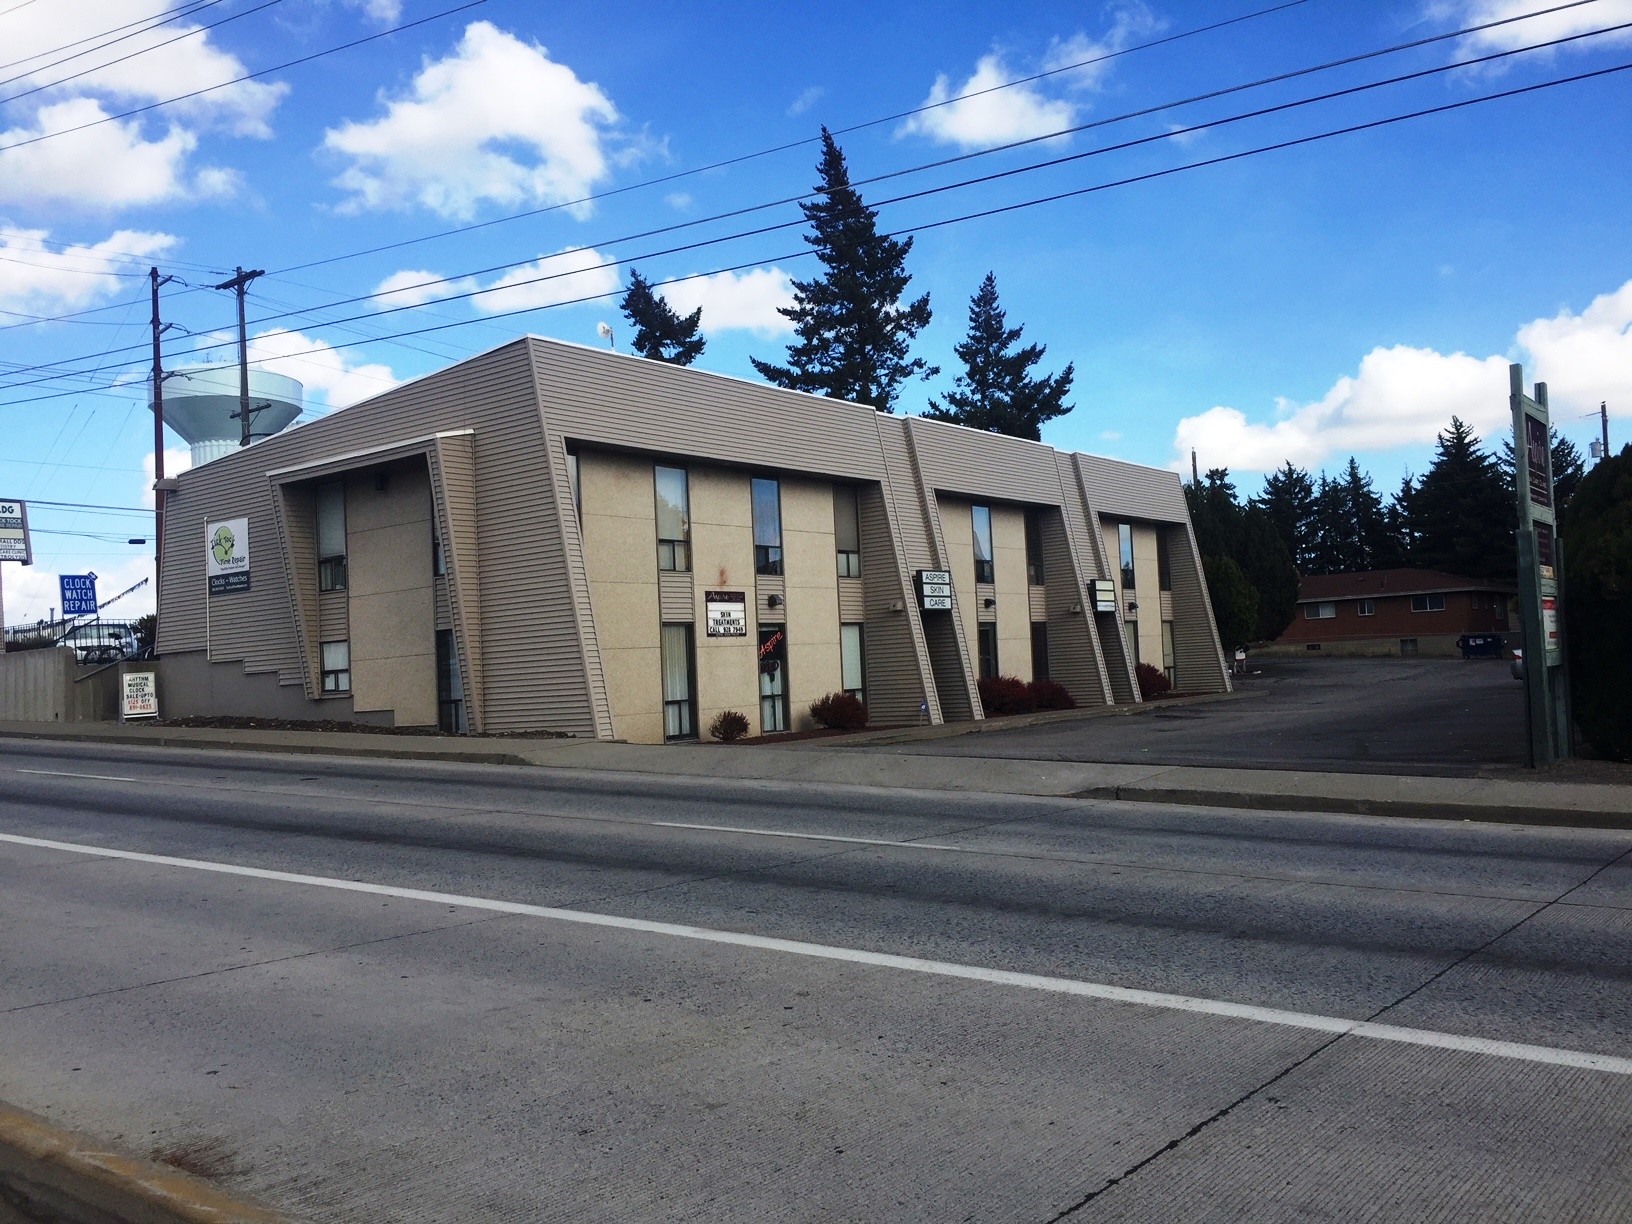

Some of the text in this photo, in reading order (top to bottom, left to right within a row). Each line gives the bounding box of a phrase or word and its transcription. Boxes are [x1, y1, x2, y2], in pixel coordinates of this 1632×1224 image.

[0, 506, 14, 514] DG
[925, 573, 946, 582] ASPIRE
[64, 578, 92, 588] CLOCK
[65, 589, 93, 599] WATCH
[930, 585, 944, 594] SKIN
[64, 600, 96, 611] REPAIR
[929, 598, 946, 607] CARE
[713, 618, 741, 626] TREATMENTS
[759, 631, 783, 659] Aspire
